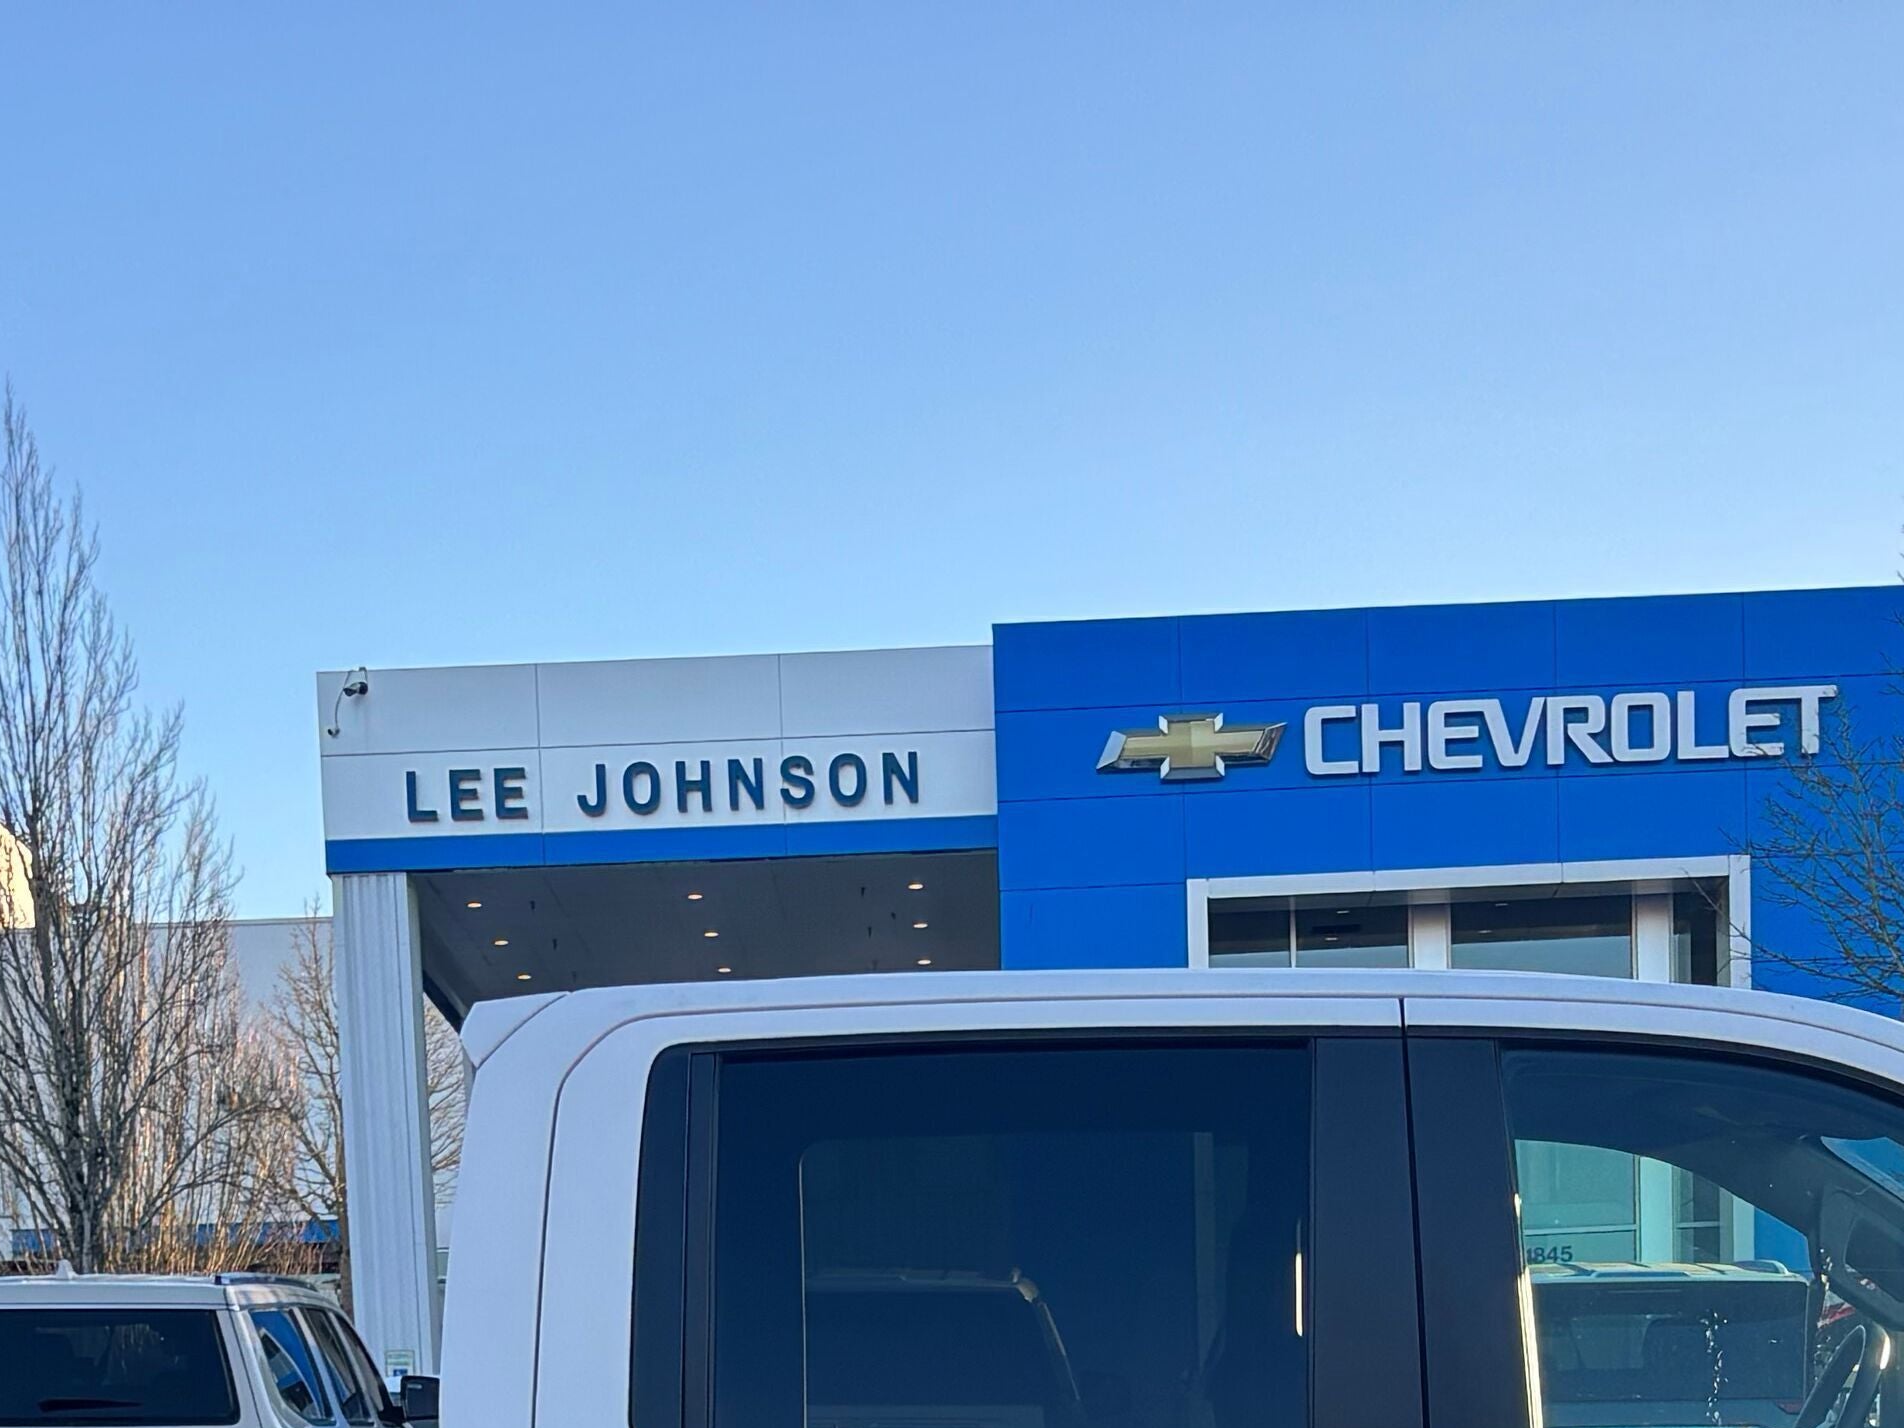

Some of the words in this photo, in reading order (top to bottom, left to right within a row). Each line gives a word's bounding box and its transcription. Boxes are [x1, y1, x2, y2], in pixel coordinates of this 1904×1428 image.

[1304, 684, 1838, 776] CHEVROLET
[406, 767, 529, 822] LEE
[577, 750, 920, 818] JOHNSON
